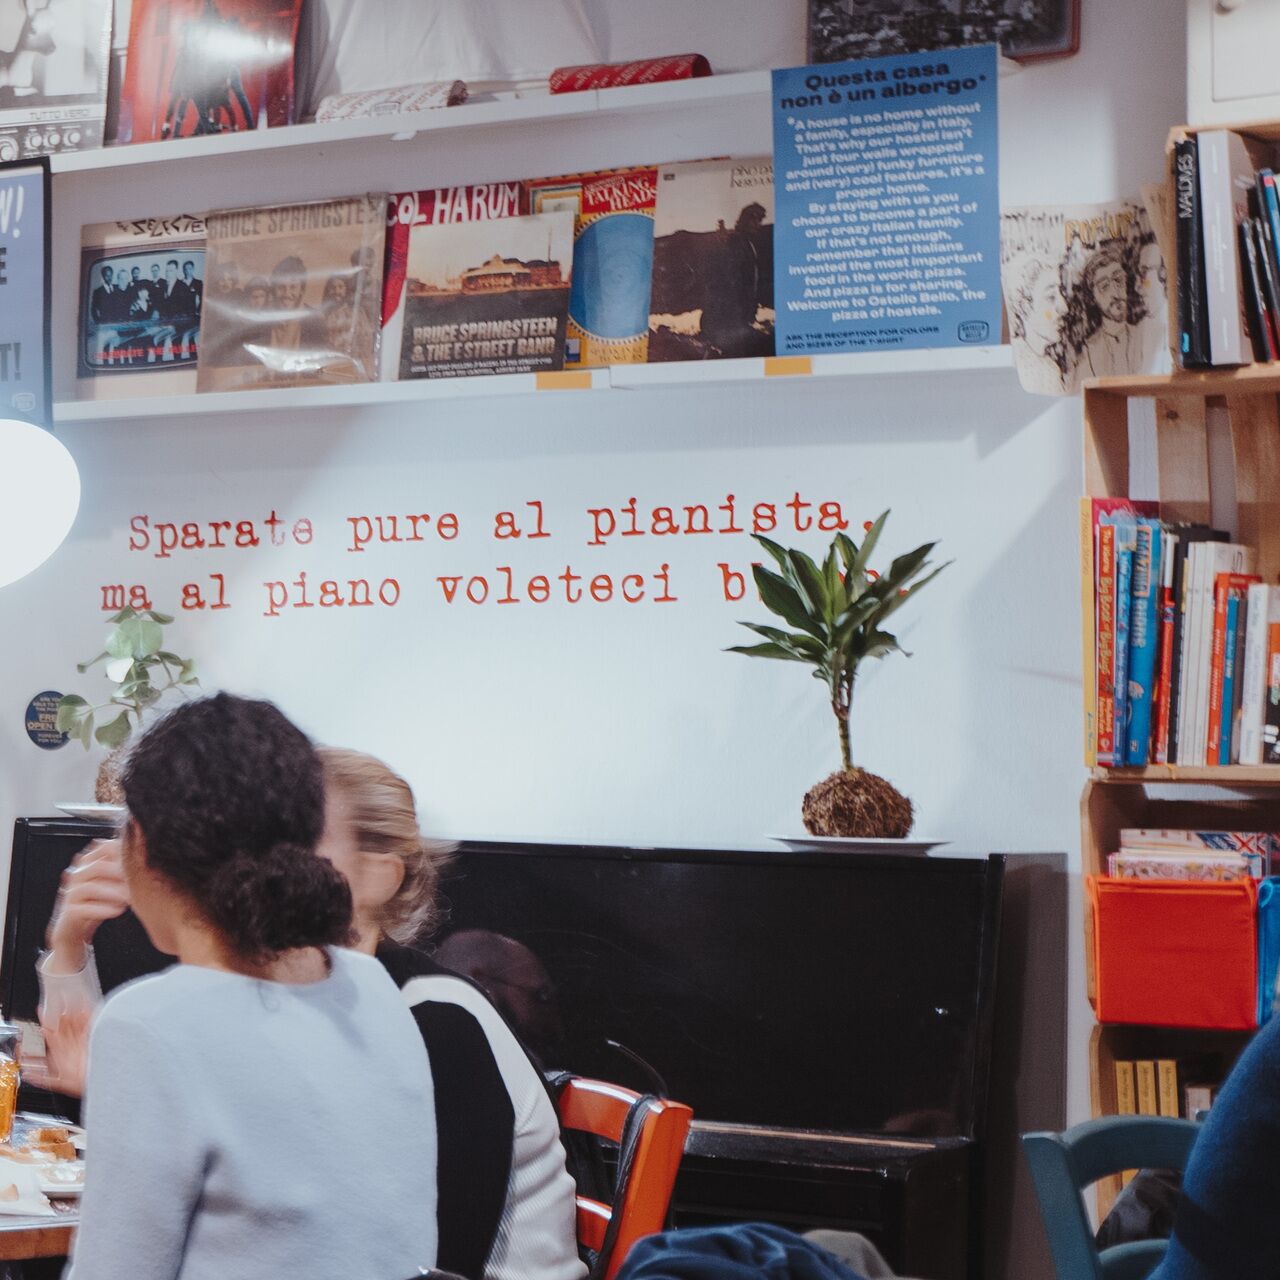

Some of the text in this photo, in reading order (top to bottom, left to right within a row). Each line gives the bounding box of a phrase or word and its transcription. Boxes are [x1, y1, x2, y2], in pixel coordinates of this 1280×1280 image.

[806, 63, 950, 91] Questa casa
[781, 94, 822, 109] non
[847, 88, 876, 103] un
[432, 182, 520, 225] HARUM
[1178, 153, 1194, 219] MALDIVES
[413, 317, 558, 345] BRUCE SPRINGSTEEN
[411, 343, 424, 363] &
[426, 342, 452, 362] THE
[464, 338, 515, 359] STREET
[517, 335, 556, 356] BAND
[128, 509, 315, 558] Sparate
[347, 509, 460, 553] pure
[493, 500, 552, 541] al
[100, 580, 154, 612] ma
[181, 573, 232, 611] al
[263, 570, 402, 618] piano
[436, 562, 679, 607] voleteci
